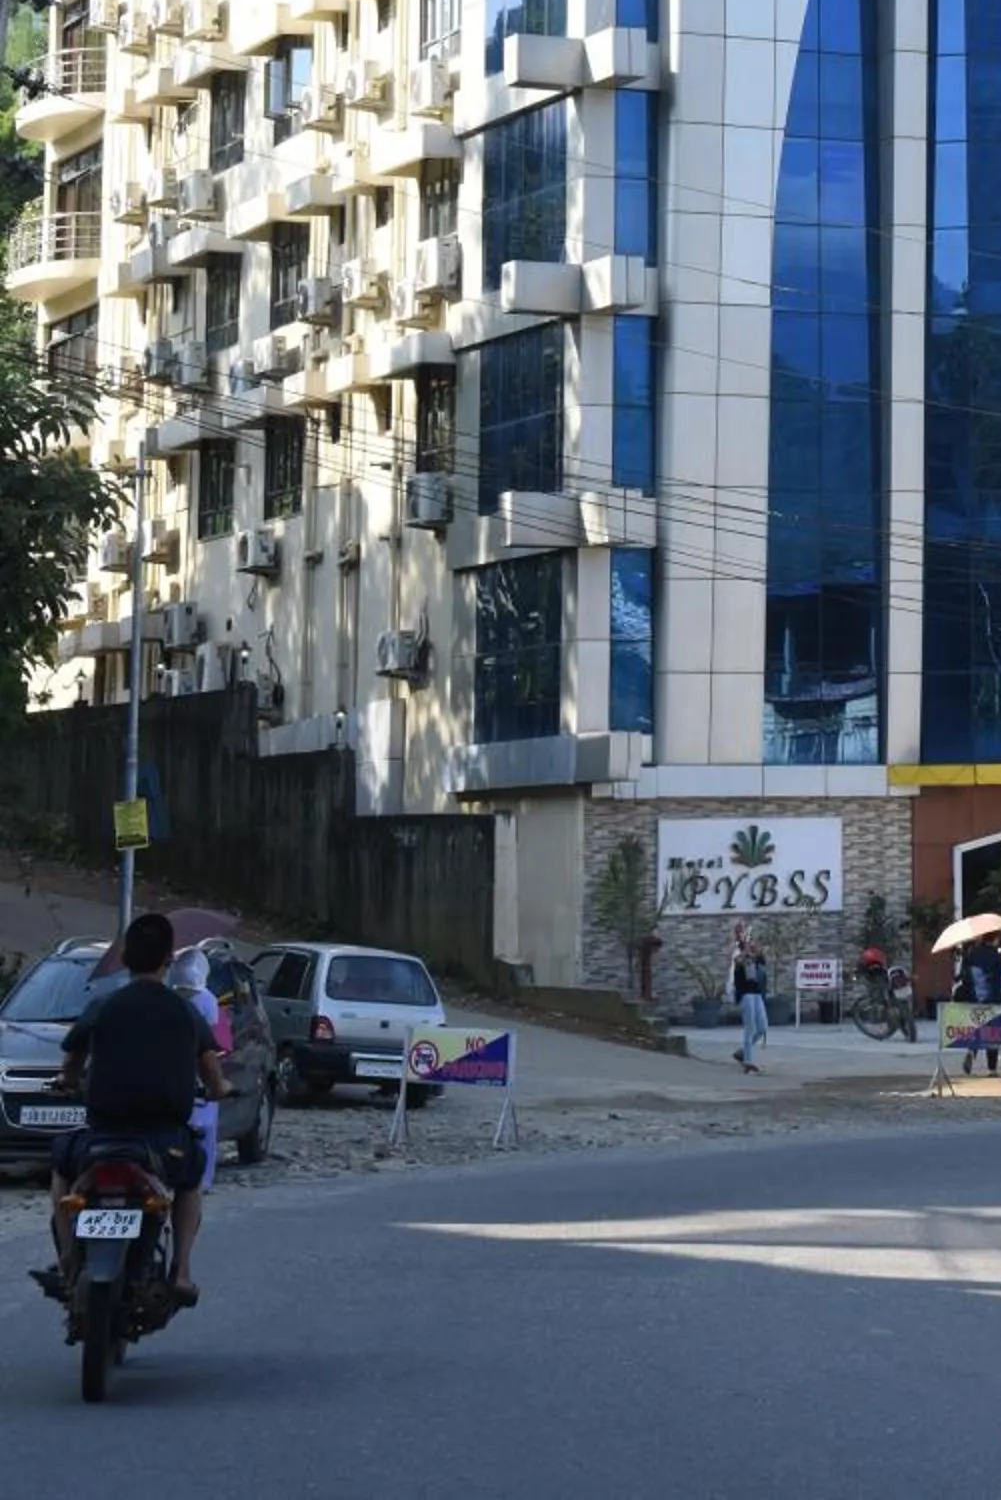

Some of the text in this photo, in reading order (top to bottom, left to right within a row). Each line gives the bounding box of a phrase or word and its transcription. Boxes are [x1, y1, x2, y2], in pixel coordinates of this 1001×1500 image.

[668, 856, 724, 870] Hotel
[681, 869, 832, 909] PYBSS
[465, 1036, 486, 1053] NO
